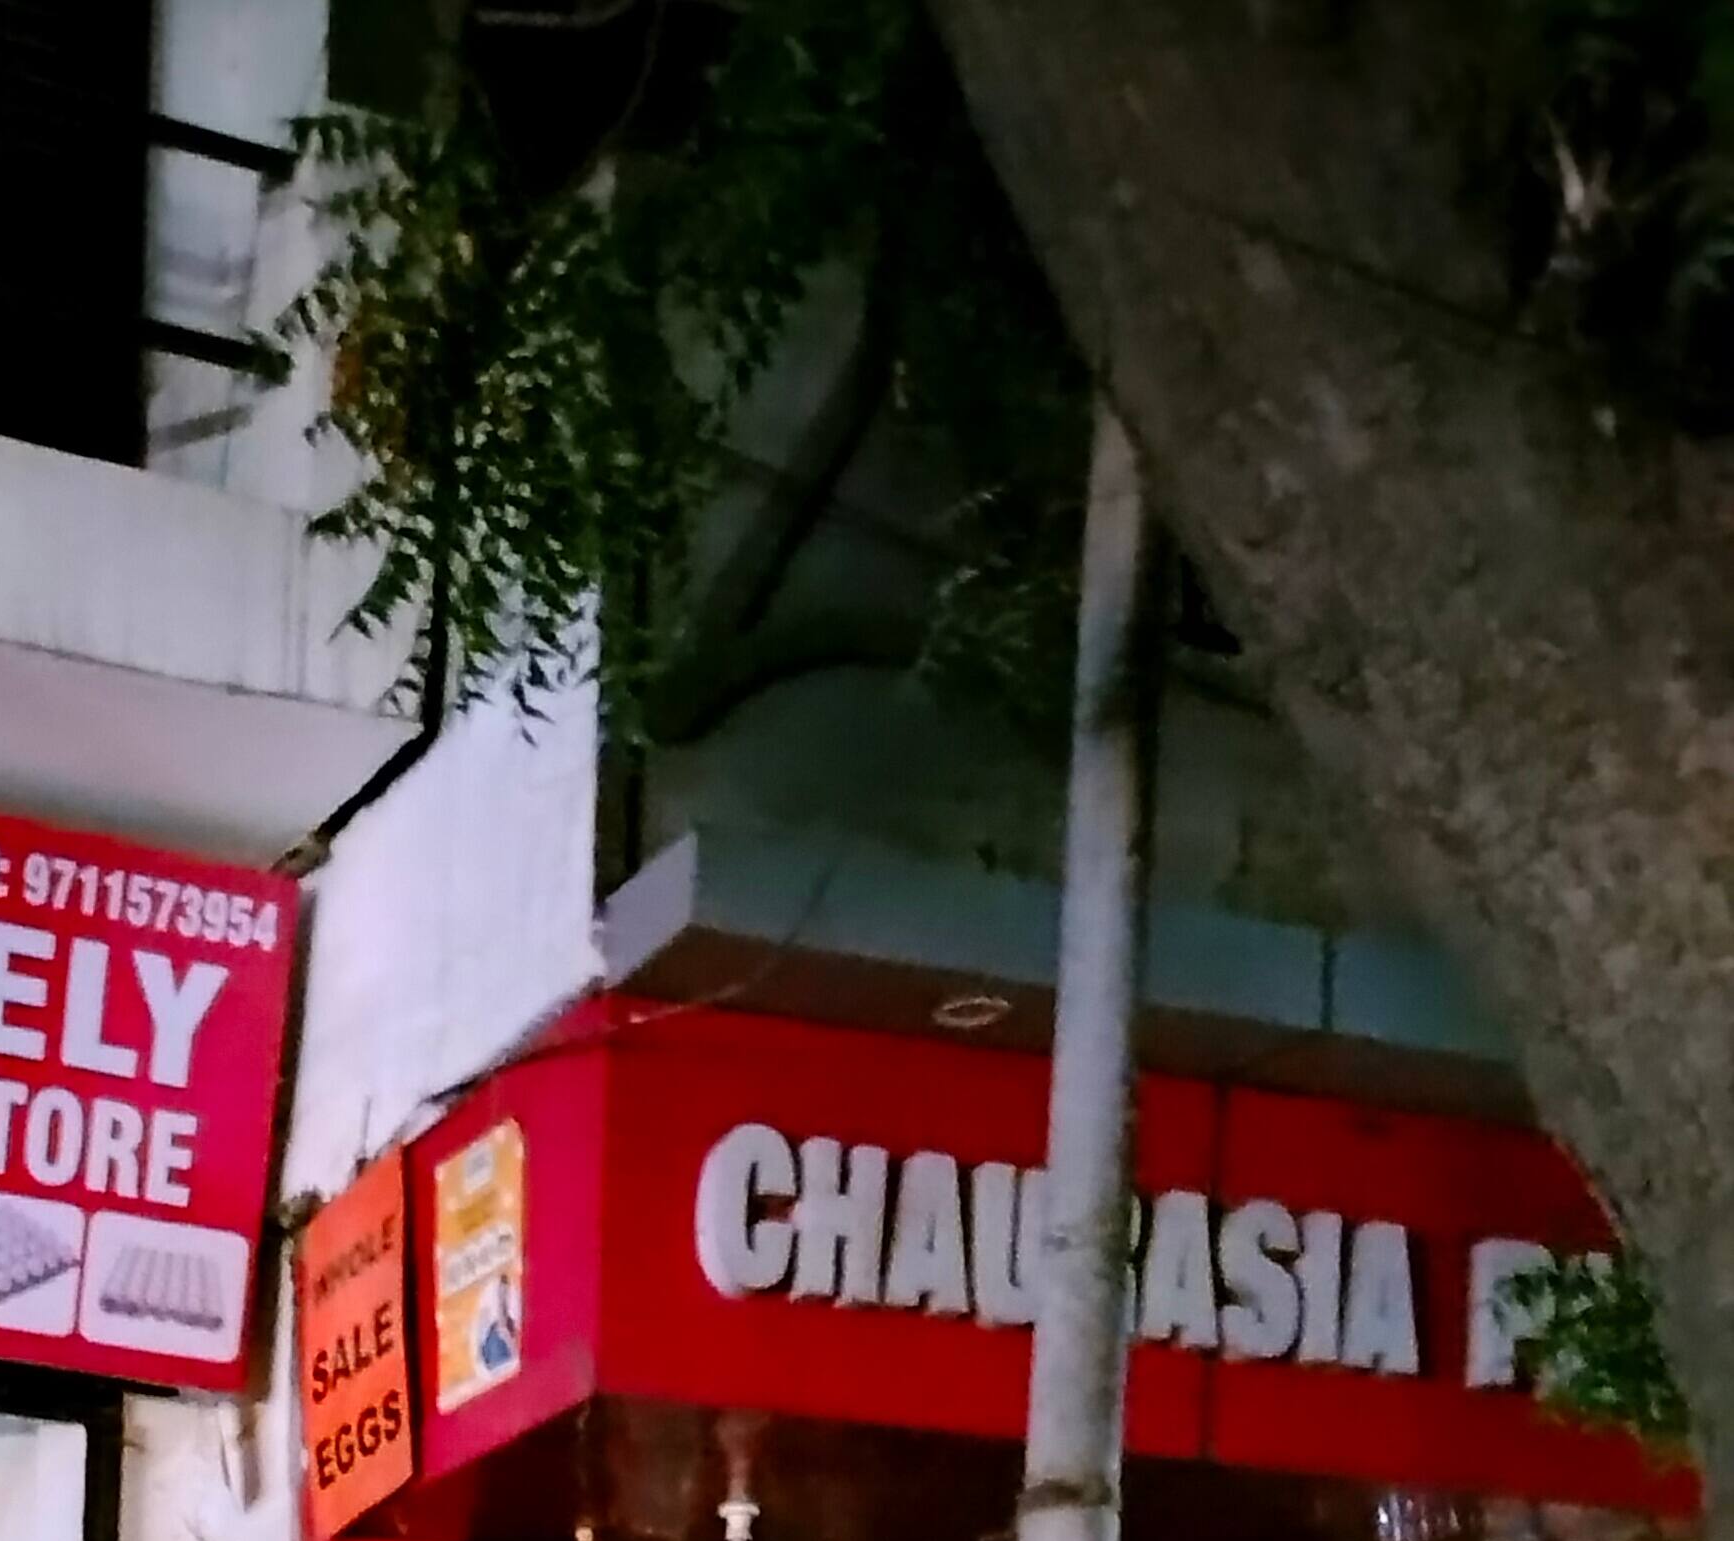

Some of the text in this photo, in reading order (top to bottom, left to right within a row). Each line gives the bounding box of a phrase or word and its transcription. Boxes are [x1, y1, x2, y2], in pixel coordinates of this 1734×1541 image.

[22, 856, 278, 952] 9711573954
[694, 1123, 1419, 1376] CHAUASIA
[311, 1300, 395, 1406] SALE
[314, 1388, 403, 1491] EGGS
